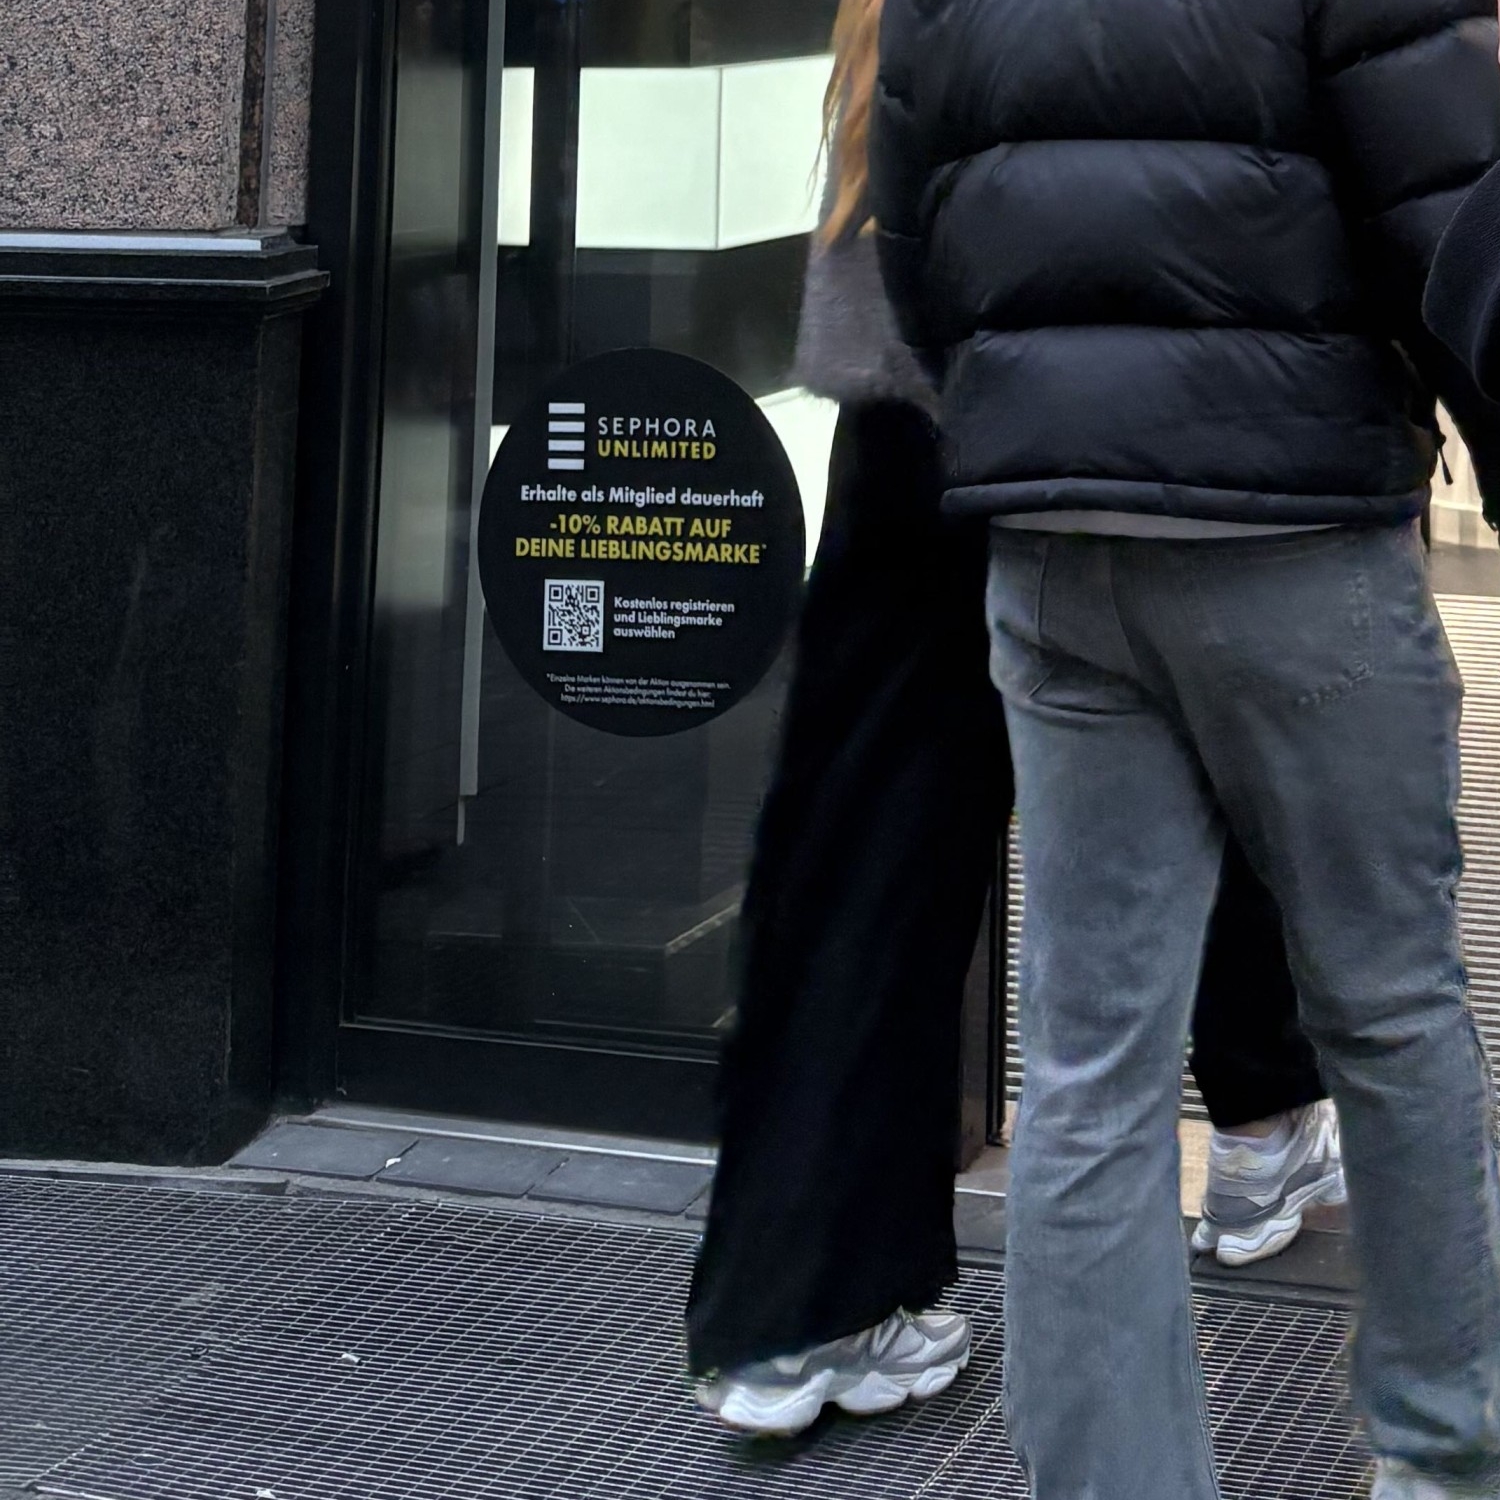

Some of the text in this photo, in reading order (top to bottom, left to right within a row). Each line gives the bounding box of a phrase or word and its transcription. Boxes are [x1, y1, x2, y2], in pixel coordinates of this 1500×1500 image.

[598, 417, 716, 438] SEPHORA
[598, 439, 716, 460] UNLIMITED
[521, 484, 764, 507] Erhalte als Mitglied dauerhaft
[550, 514, 732, 538] -10% RABATT AUF
[516, 538, 575, 558] DEINE
[614, 596, 735, 614] Kostenlos registrieren
[614, 610, 723, 628] und Lieblingsmarke
[613, 624, 676, 639] auswählen
